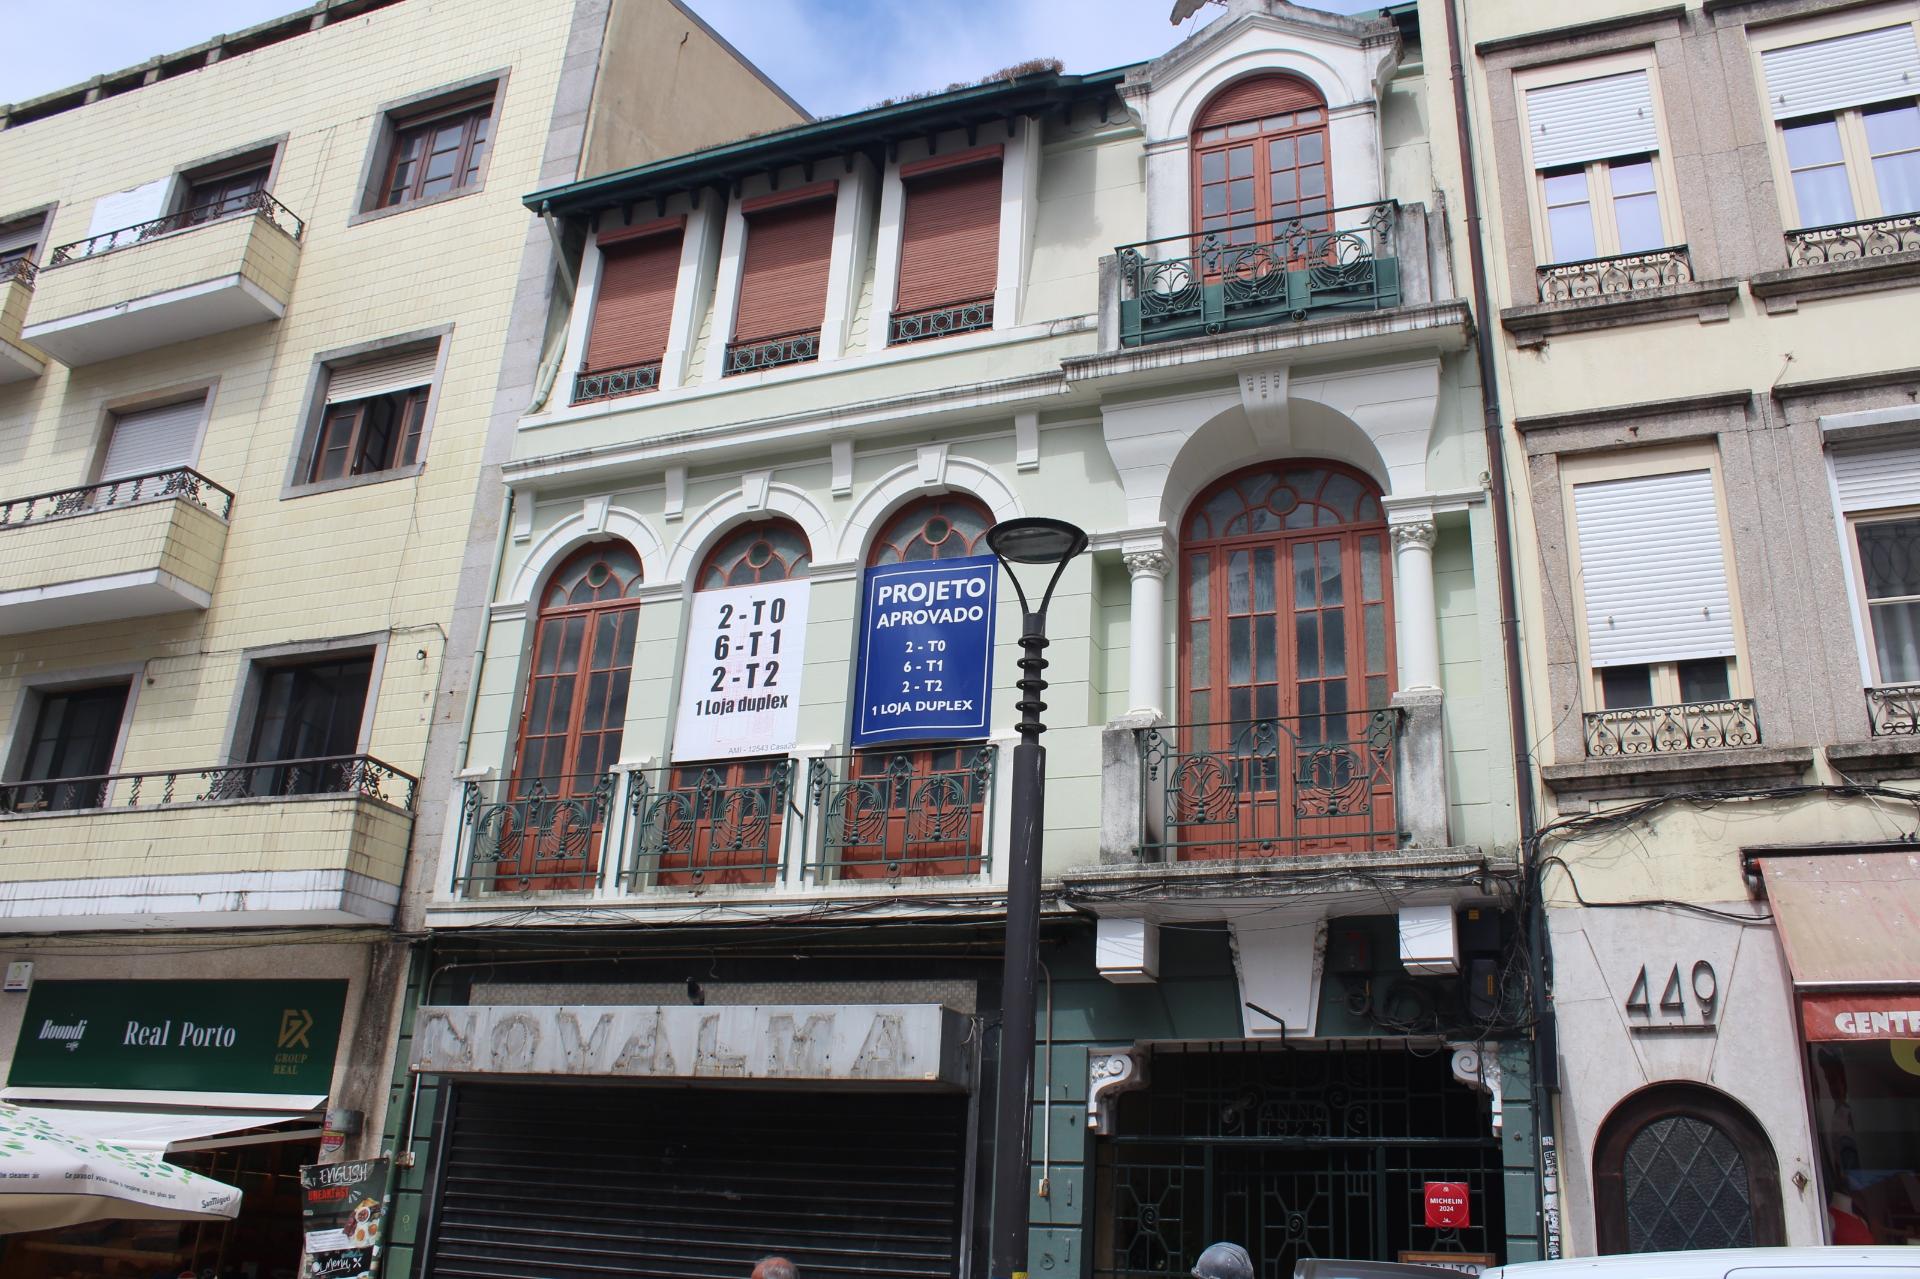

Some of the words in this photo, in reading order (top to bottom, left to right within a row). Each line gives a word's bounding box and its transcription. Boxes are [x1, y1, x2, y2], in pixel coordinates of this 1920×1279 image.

[878, 578, 986, 607] PROJETO
[876, 606, 984, 629] APROVADO
[905, 641, 913, 653] 2
[903, 661, 912, 673] 6
[926, 660, 944, 672] T1
[902, 681, 910, 693] 2
[925, 680, 943, 692] T2
[695, 700, 702, 716] 1
[704, 699, 734, 716] Loja
[737, 693, 789, 713] duplex
[871, 706, 877, 716] 1
[881, 702, 912, 716] LOJA
[915, 699, 973, 712] DUPLEX
[1626, 960, 1717, 1018] 449
[39, 1019, 88, 1040] Buondi
[122, 1019, 171, 1046] Real
[178, 1021, 237, 1048] Porto
[422, 1012, 918, 1077] NOVALMA
[275, 1053, 308, 1064] GROUP
[272, 1064, 299, 1075] REAL
[319, 1162, 368, 1184] ENGLISH
